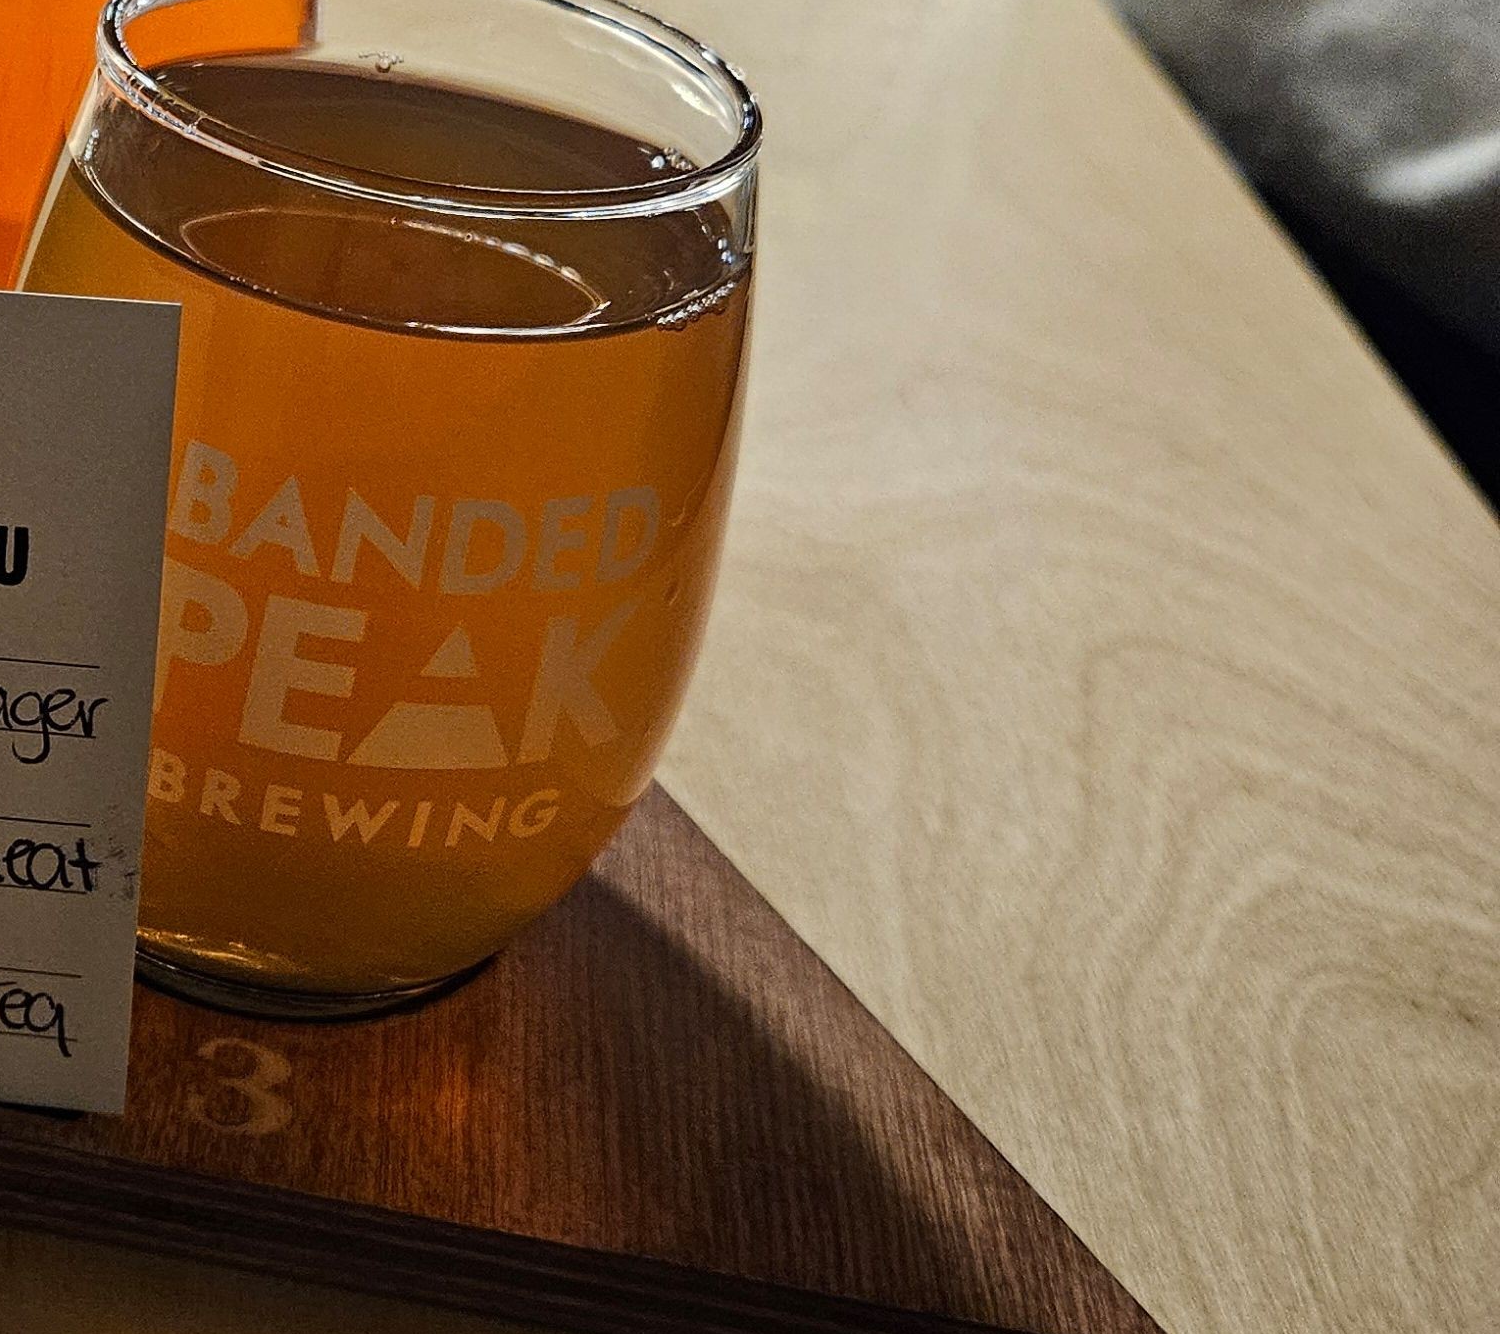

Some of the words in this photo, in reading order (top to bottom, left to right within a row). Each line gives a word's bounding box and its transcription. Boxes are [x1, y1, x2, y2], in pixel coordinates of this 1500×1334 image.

[169, 439, 661, 595] BANDED
[146, 747, 560, 849] BREWING
[188, 1037, 293, 1136] 3
